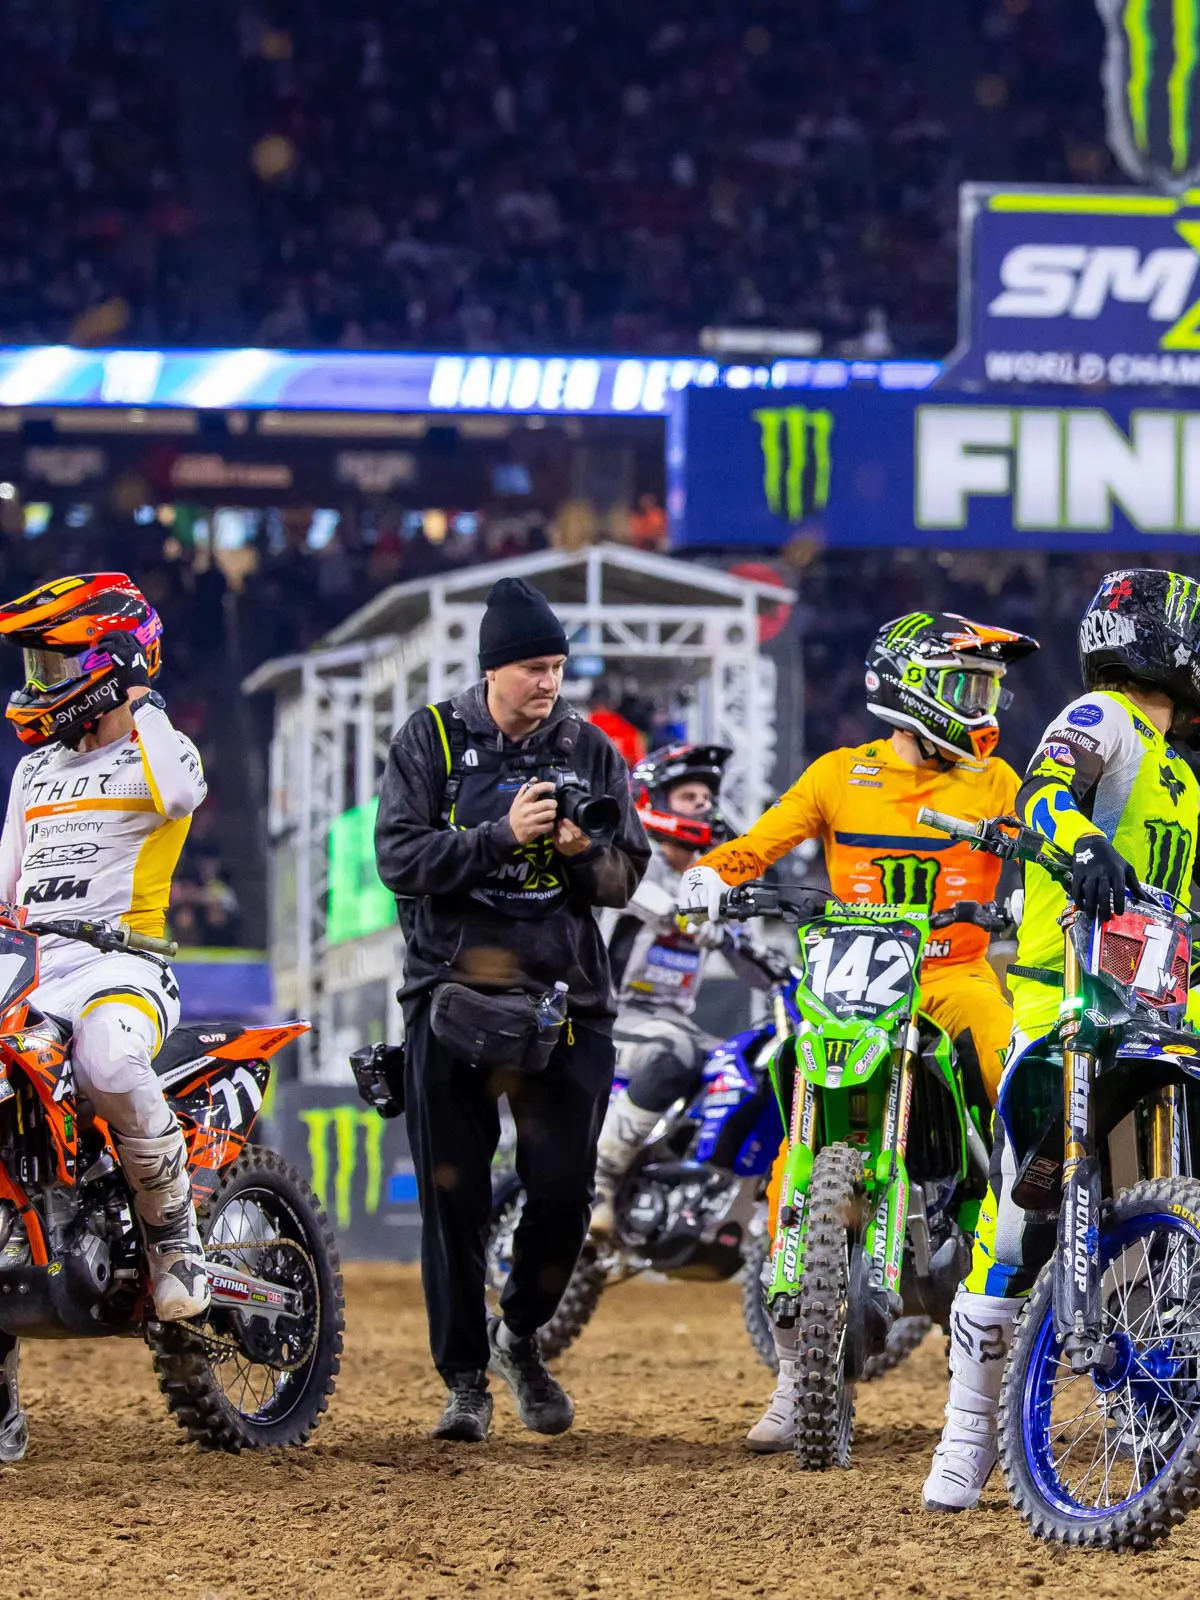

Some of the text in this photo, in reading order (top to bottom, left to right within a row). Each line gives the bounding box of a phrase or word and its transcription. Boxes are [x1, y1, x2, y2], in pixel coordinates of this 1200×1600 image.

[986, 352, 1104, 384] WORLD
[56, 677, 119, 724] synchron
[1051, 729, 1096, 752] AMALUBE
[40, 820, 104, 838] synchrony
[23, 875, 92, 905] KTM
[807, 935, 915, 1007] 142
[1128, 924, 1174, 992] 1
[888, 1063, 900, 1120] CIRCUIT
[783, 1188, 806, 1283] DNLOP
[1074, 1185, 1091, 1293] DUNLOP
